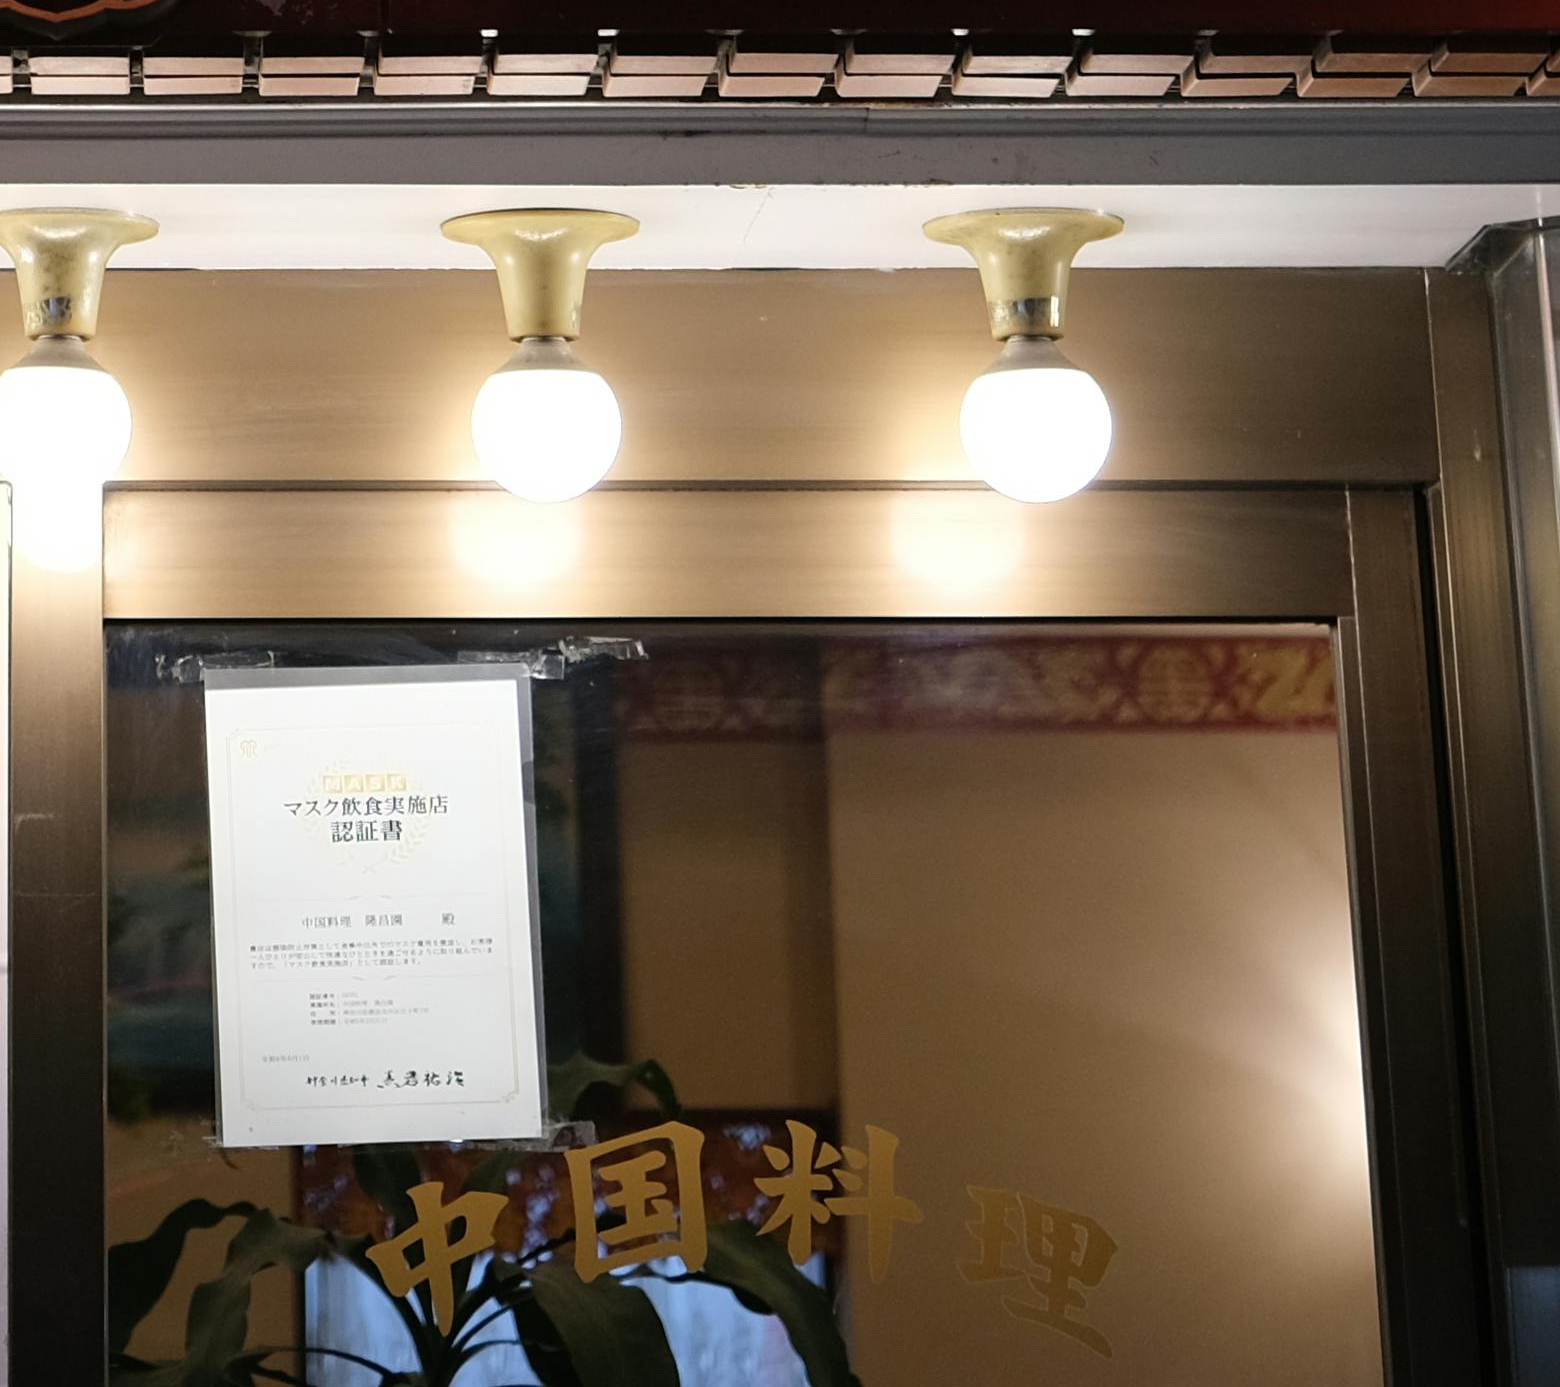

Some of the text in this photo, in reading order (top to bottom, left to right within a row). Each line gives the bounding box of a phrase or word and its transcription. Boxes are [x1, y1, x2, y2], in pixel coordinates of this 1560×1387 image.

[283, 794, 449, 816] マスク飲食実施店
[331, 820, 403, 843] 認証書
[365, 1119, 1120, 1360] 中国料理
